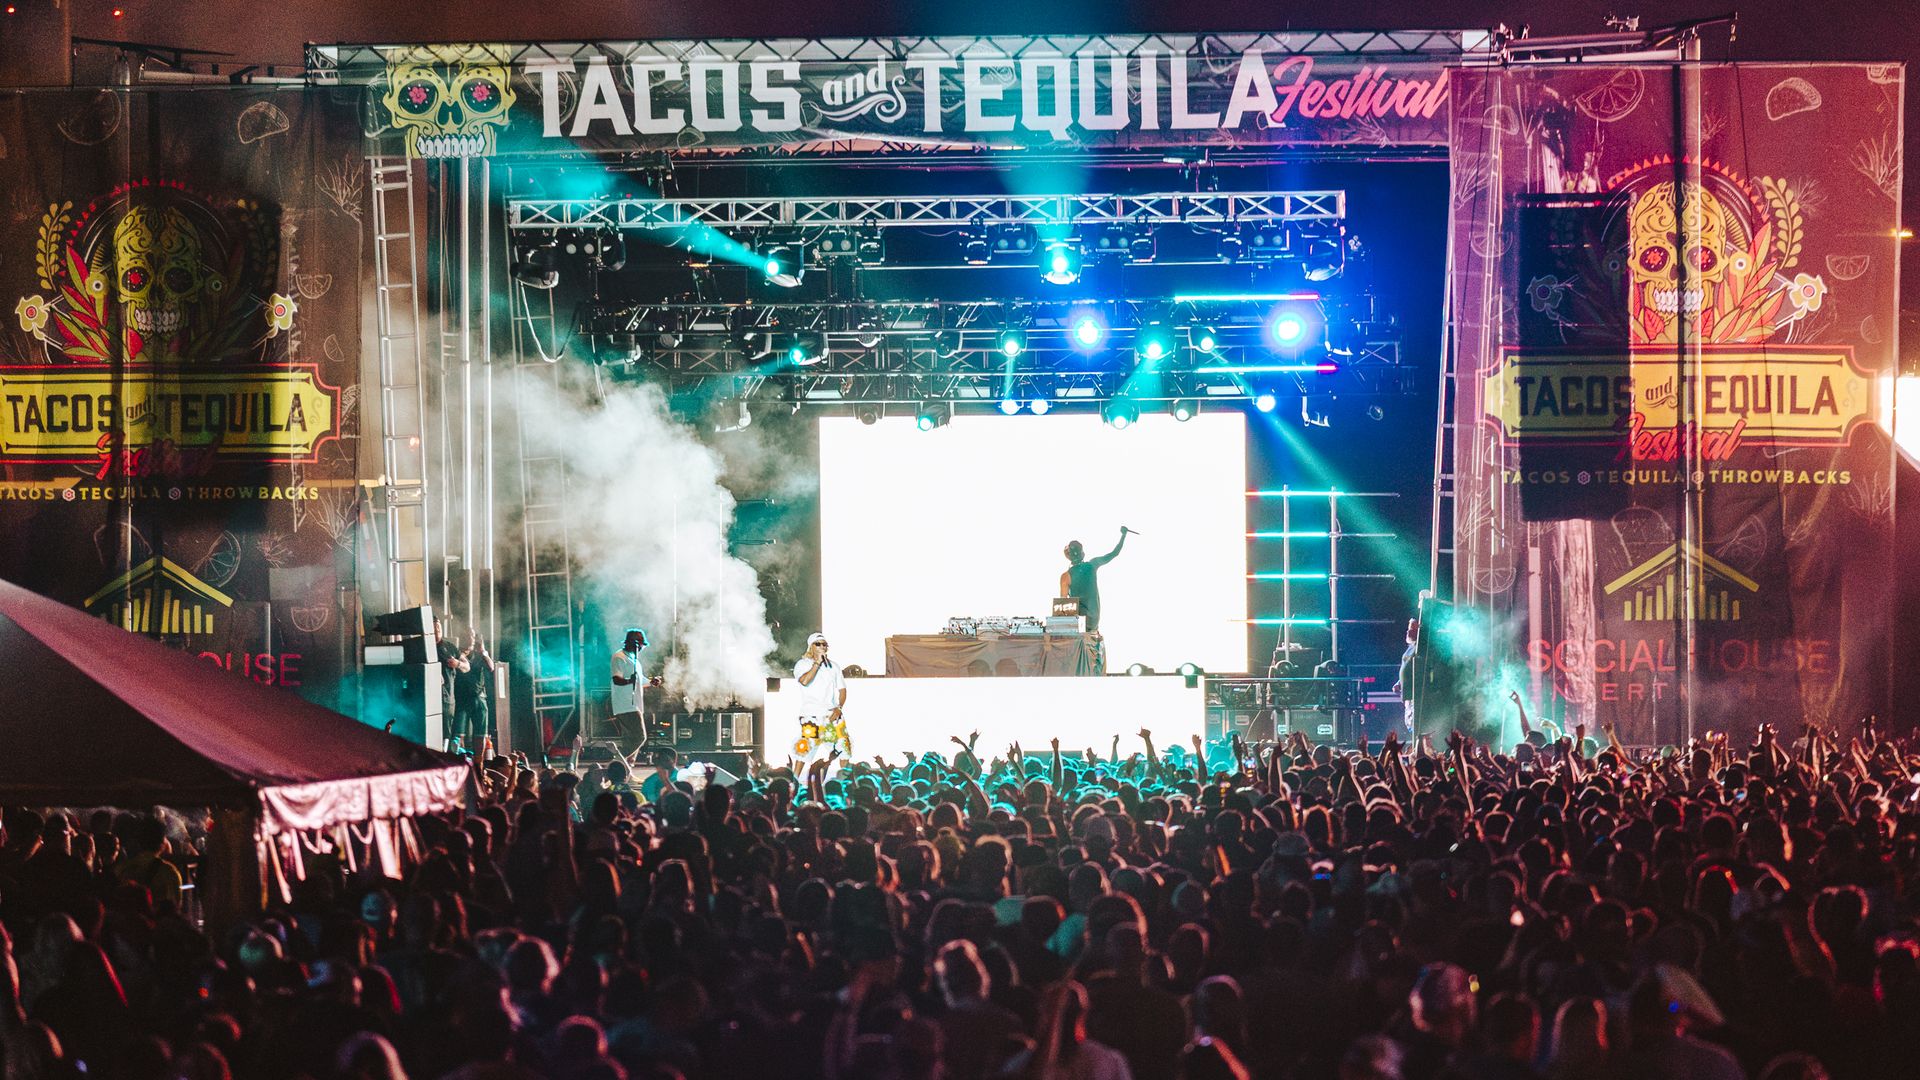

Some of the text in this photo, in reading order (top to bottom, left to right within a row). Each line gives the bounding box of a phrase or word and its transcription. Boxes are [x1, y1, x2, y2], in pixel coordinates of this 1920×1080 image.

[525, 49, 1449, 140] TACOS and TEQUILA Festival
[6, 394, 116, 433] TACOS
[156, 392, 308, 433] TEQUILA
[1514, 375, 1635, 417] TACOS
[1682, 375, 1840, 421] TEQUILA
[187, 486, 319, 501] THROWBACKS
[1502, 470, 1852, 486] TACOS TEQUILA THROWBACKS
[1526, 639, 1677, 673] SOCIAL
